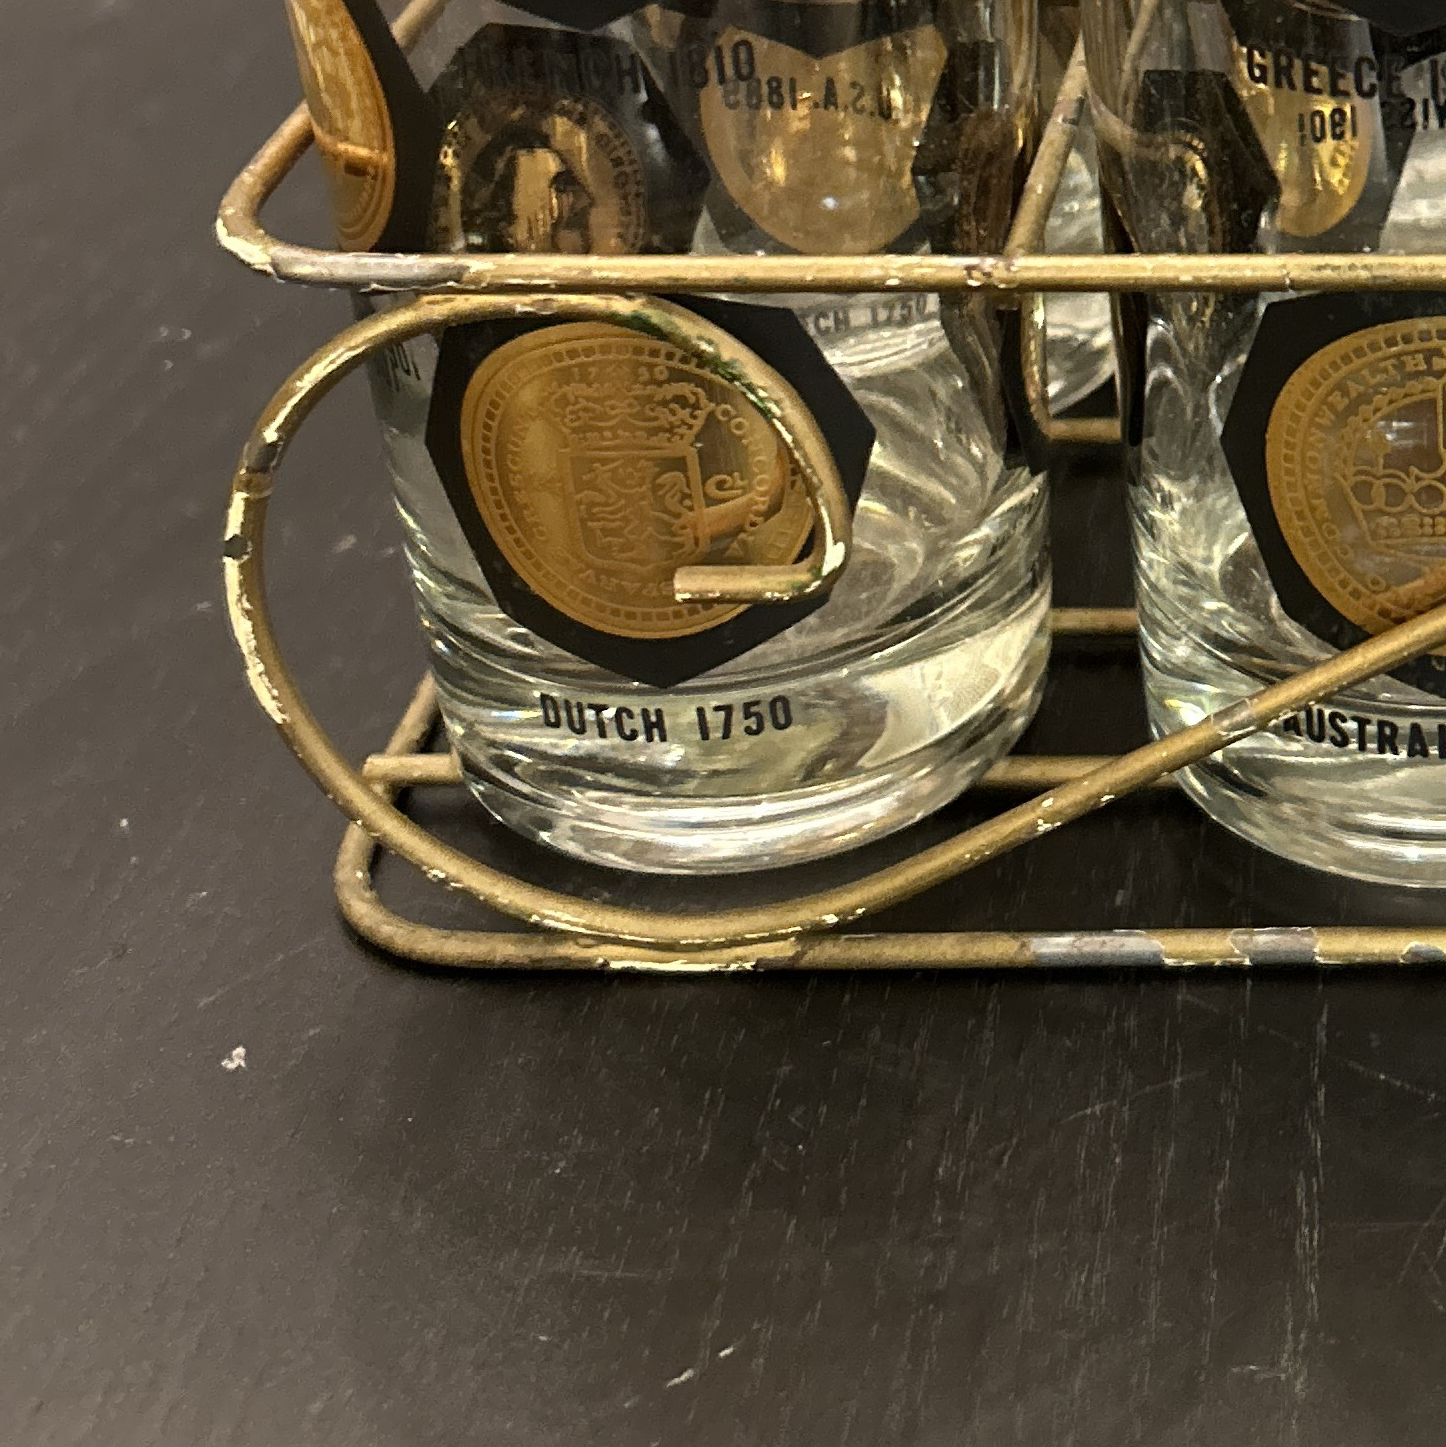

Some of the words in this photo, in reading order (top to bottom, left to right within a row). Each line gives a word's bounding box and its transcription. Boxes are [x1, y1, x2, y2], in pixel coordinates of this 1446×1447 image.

[1245, 42, 1402, 99] GREECE
[540, 693, 667, 743] DUTCH
[699, 695, 793, 742] 1750
